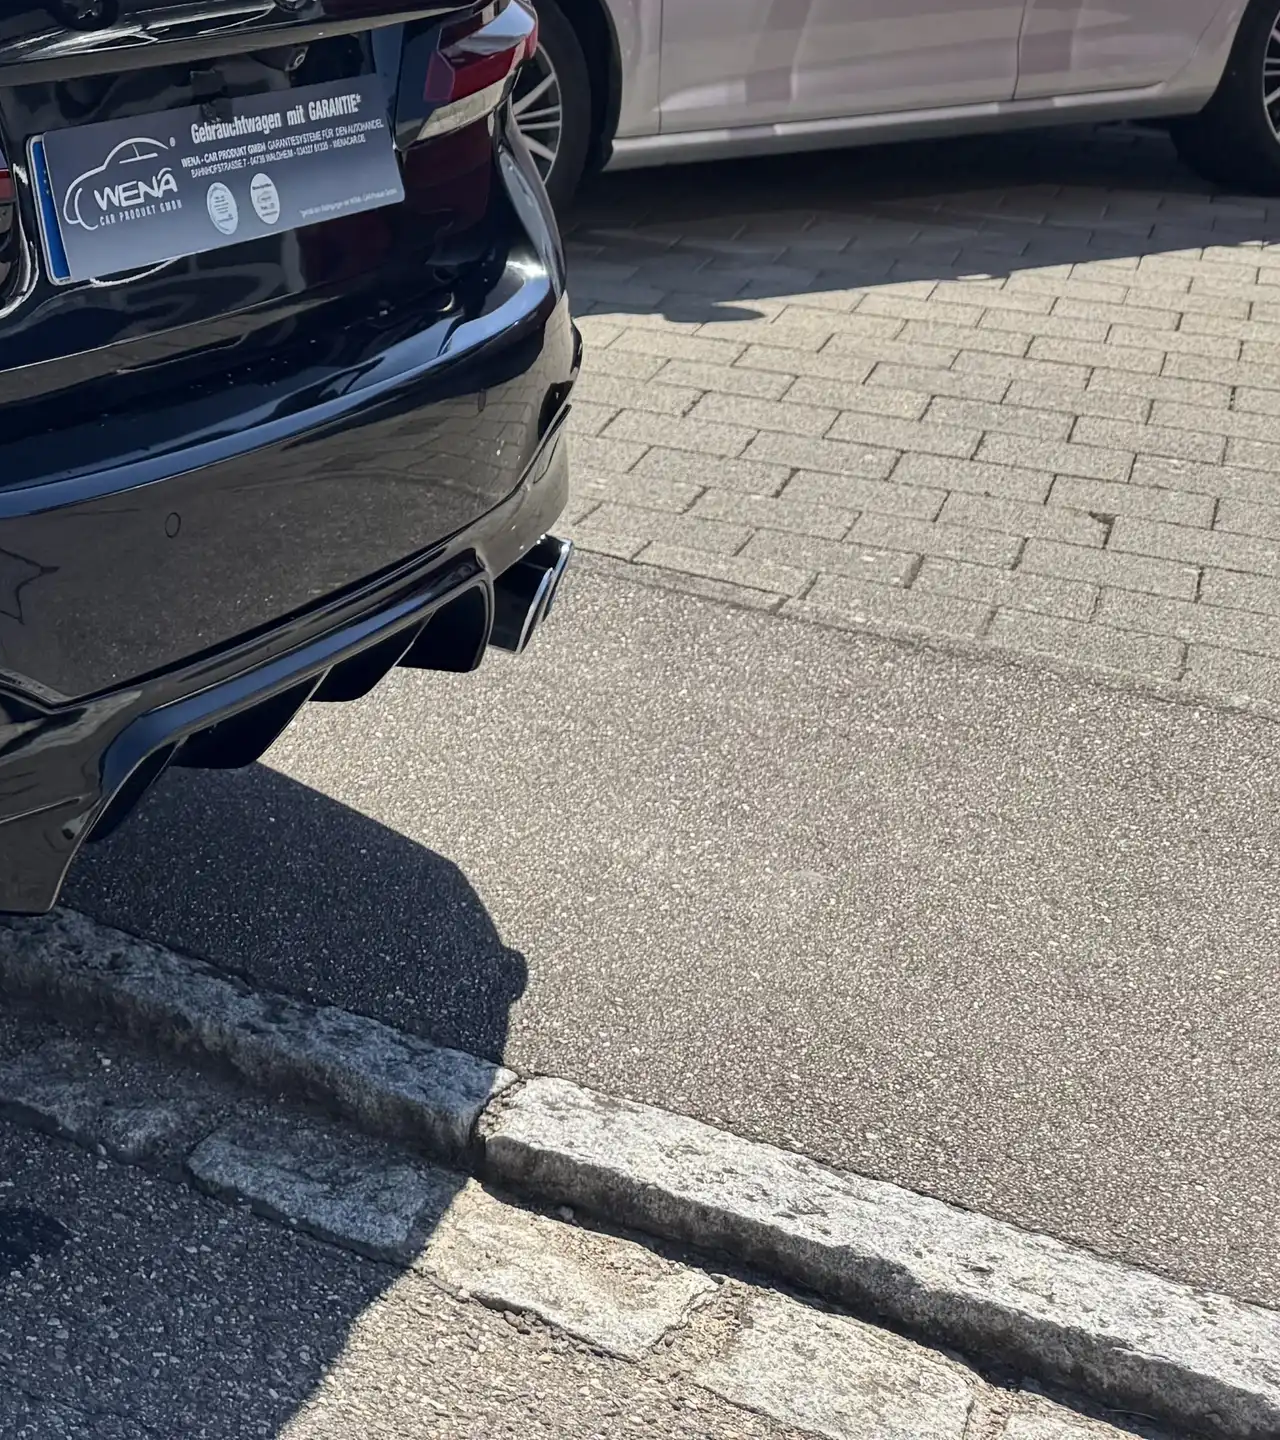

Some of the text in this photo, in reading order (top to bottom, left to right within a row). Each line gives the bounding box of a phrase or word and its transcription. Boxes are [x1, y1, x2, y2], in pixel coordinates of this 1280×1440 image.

[191, 111, 281, 144] Gebrauchtwagen
[287, 104, 305, 125] mit
[100, 214, 116, 226] CAR
[119, 205, 156, 221] PRODUKT
